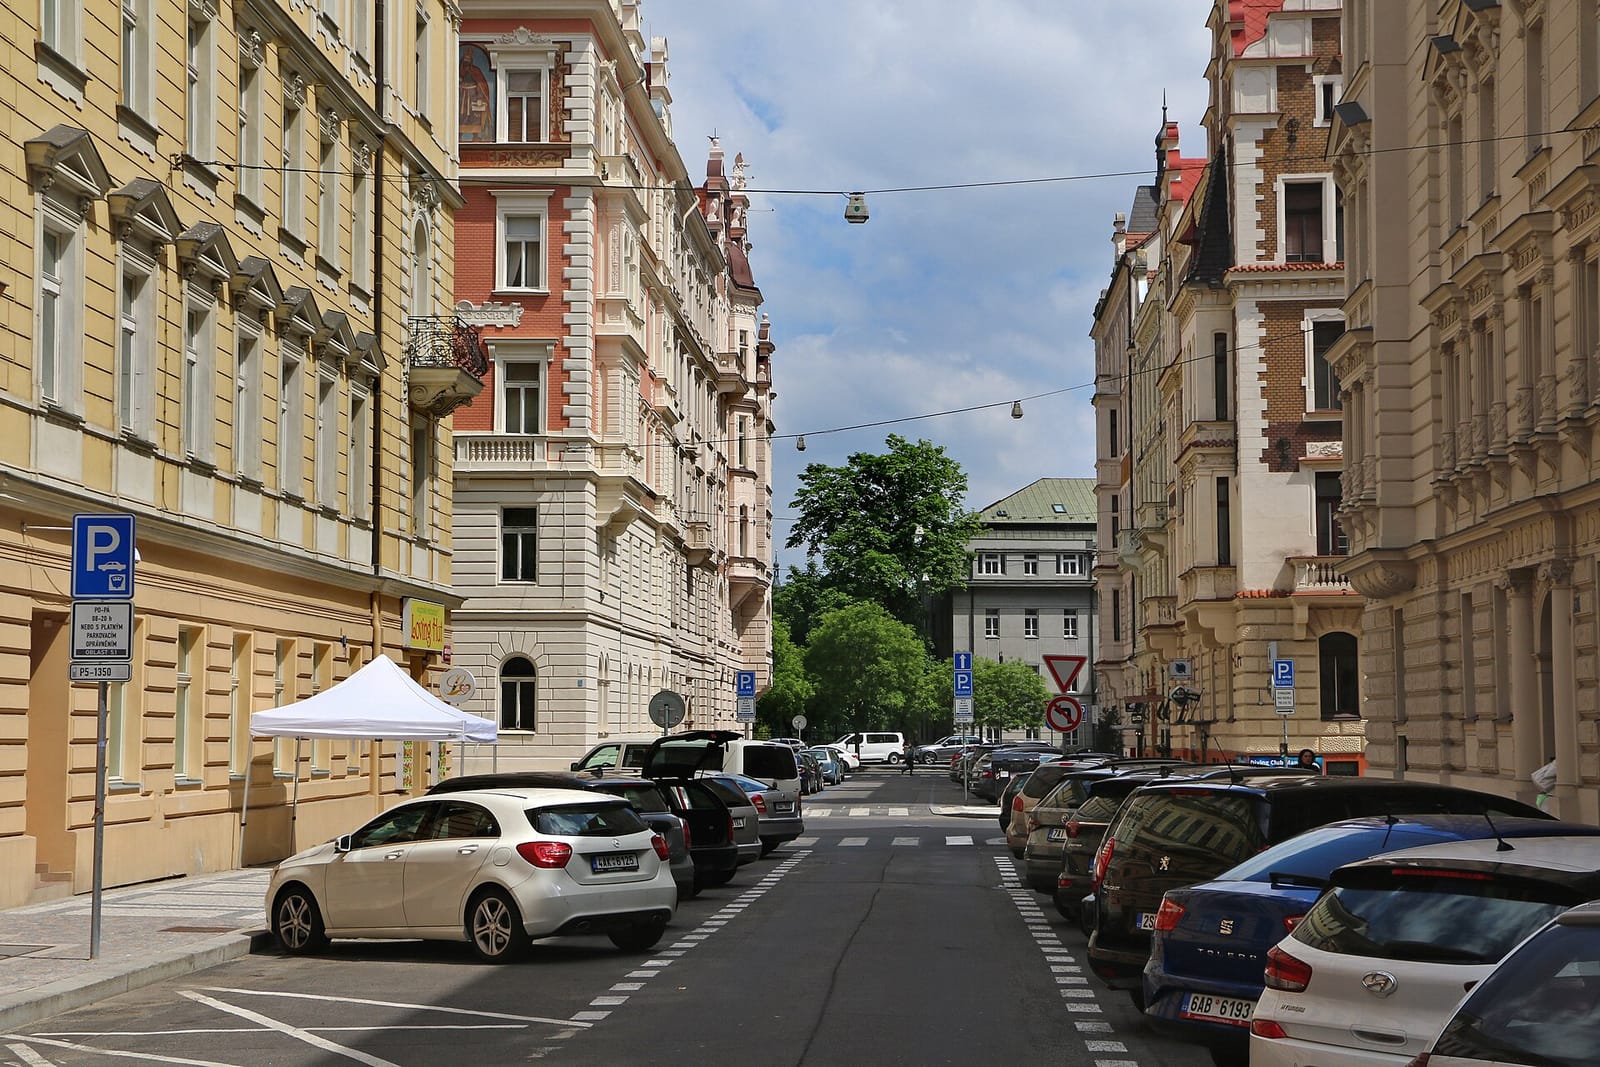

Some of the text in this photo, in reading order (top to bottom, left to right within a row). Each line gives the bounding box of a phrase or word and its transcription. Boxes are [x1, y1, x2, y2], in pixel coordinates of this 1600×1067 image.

[87, 525, 120, 572] P
[411, 613, 443, 648] Loving Hut
[79, 667, 112, 677] P5-1350
[1278, 663, 1290, 679] P
[741, 674, 751, 690] P
[957, 674, 968, 690] P
[1143, 914, 1158, 928] 2S
[1190, 996, 1213, 1013] 6AB
[1220, 999, 1251, 1019] 6193
